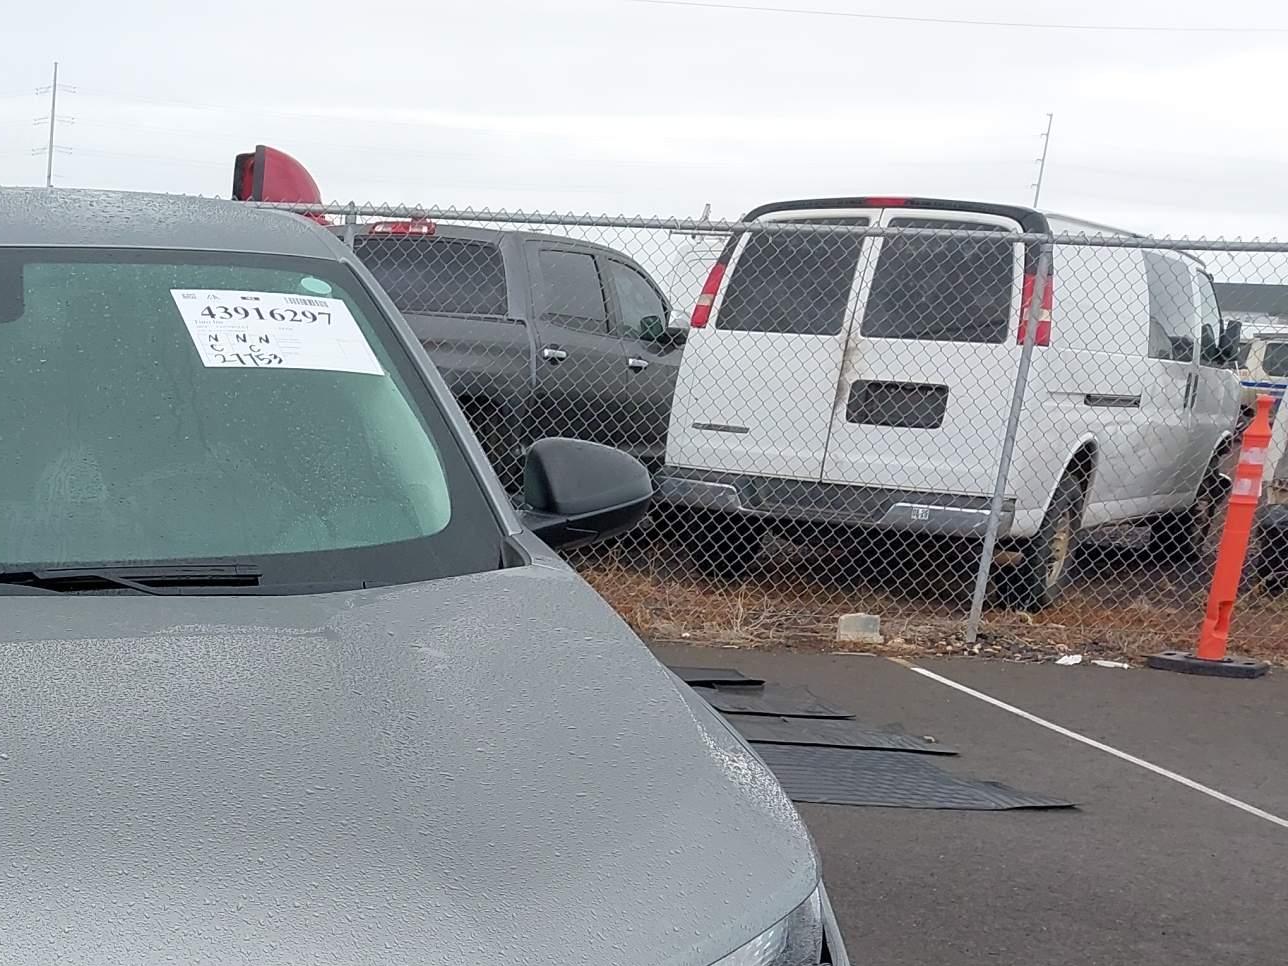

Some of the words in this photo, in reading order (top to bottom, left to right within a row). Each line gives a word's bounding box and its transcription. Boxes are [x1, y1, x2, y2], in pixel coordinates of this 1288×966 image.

[201, 305, 332, 326] 43916297
[208, 333, 219, 342] N
[235, 333, 247, 343] N
[258, 334, 270, 344] N
